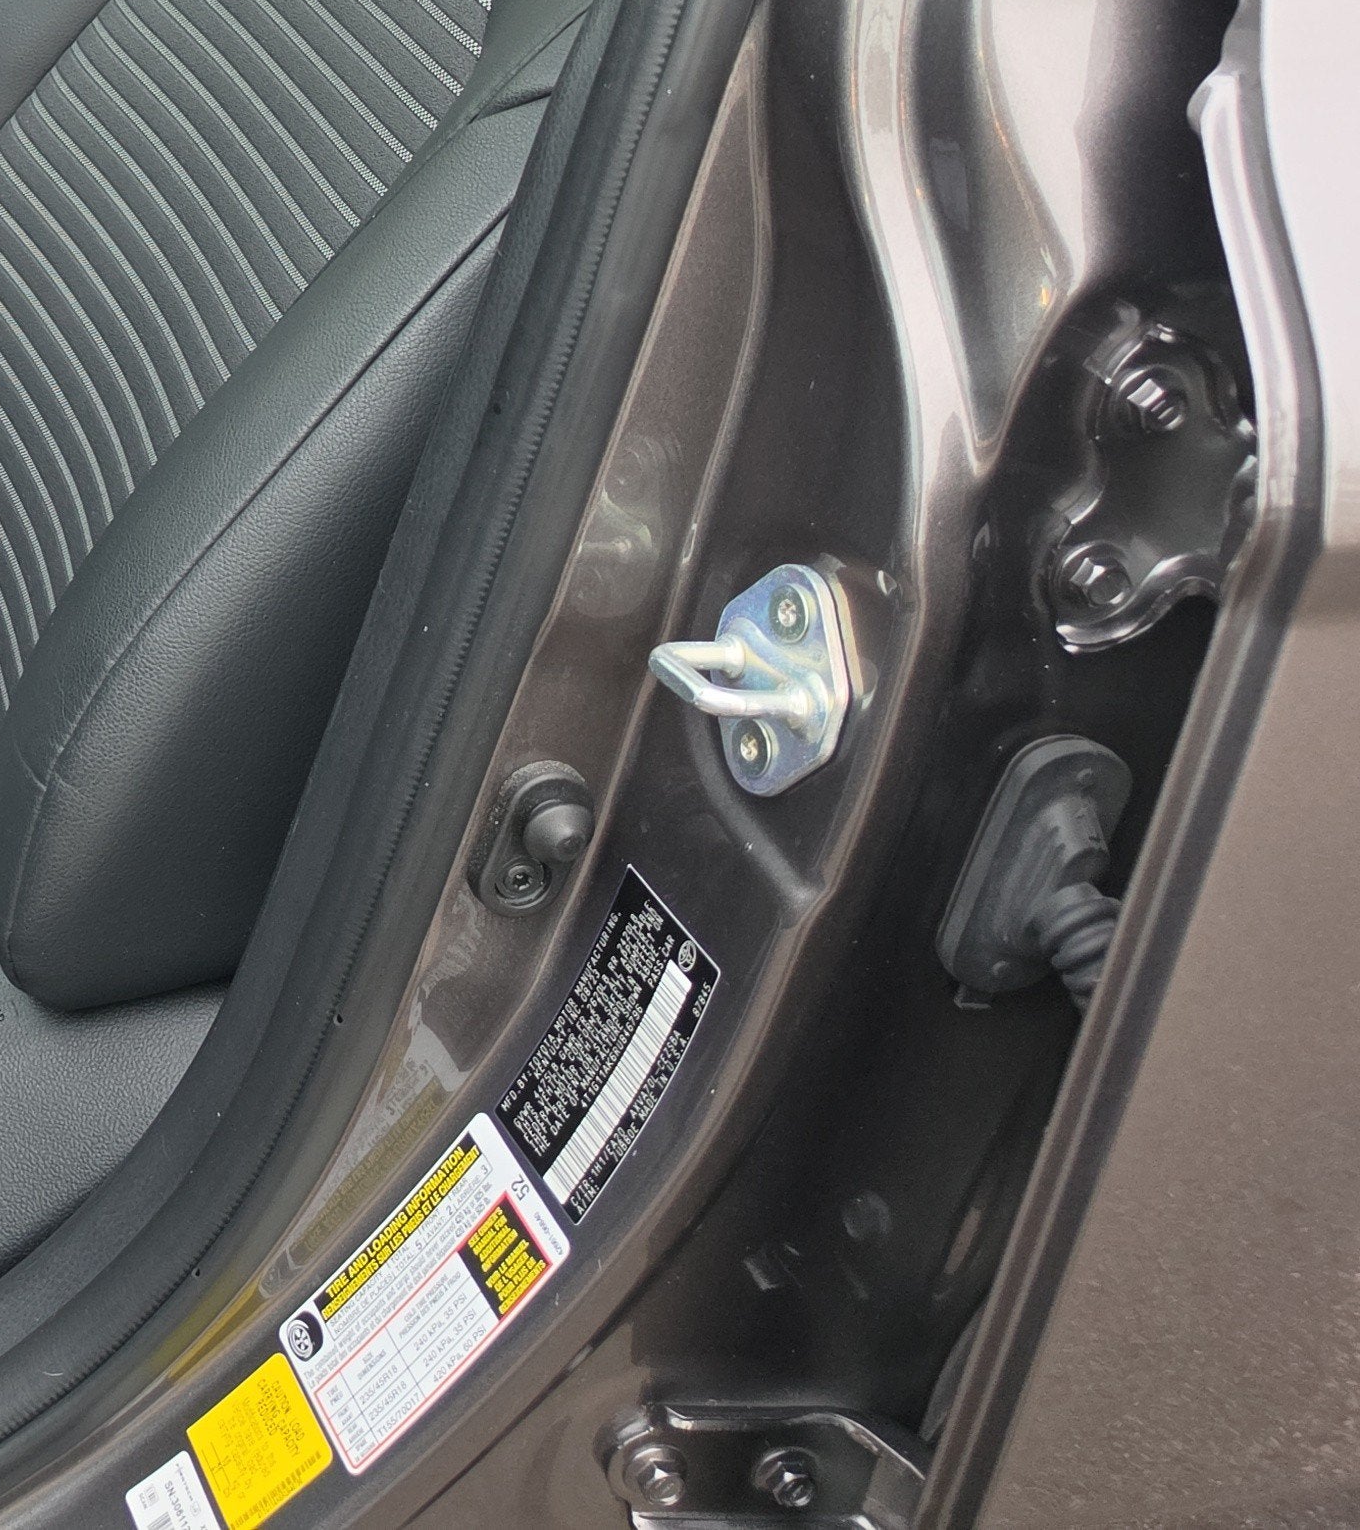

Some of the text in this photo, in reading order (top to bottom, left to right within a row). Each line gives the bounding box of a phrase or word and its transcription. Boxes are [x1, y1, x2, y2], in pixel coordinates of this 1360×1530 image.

[513, 911, 638, 1129] GVWR 4475LB GAWR FR 2620LB RR 2420LB
[518, 900, 652, 1136] THIS VEHICLE CONFORMS TO ALL APPLICABLE
[523, 1097, 554, 1144] FEDERAL
[553, 1062, 577, 1099] MOTOR
[576, 1016, 605, 1064] VEHICLE
[643, 906, 658, 931] AND
[529, 913, 664, 1151] THEFT PREVENTION STANDARDS IN EFFECT ON
[553, 996, 576, 1033] MOTOR
[534, 1135, 550, 1158] THE
[549, 1106, 570, 1136] DATE
[569, 1089, 581, 1107] OF
[580, 1018, 623, 1091] MANUFACTURE
[621, 982, 642, 1018] SHOWN
[637, 1090, 656, 1121] MADE
[656, 1071, 667, 1088] IN
[451, 1177, 468, 1196] REAR
[480, 1163, 488, 1175] 3
[509, 1173, 531, 1201] 52
[321, 1144, 482, 1322] RENSEIGNEMENTS SUR LES PNEUS ET LE CHARGEMENT
[325, 1145, 466, 1300] TIRE AND LOADING INFORMATION
[420, 1207, 441, 1231] FRONT
[445, 1204, 454, 1216] 2
[466, 1205, 504, 1249] SEE OWNER'S
[390, 1242, 409, 1265] TOTAL
[414, 1238, 423, 1251] 5
[471, 1214, 508, 1256] MANUAL FOR
[476, 1222, 512, 1263] ADDITIONAL
[479, 1227, 520, 1273] INFORMATION
[484, 1237, 530, 1289] VOIR LE MANUEL
[493, 1278, 505, 1293] DE
[497, 1255, 536, 1302] POUR PLUS DE
[329, 1269, 383, 1328] SEATING CAPACITY
[334, 1273, 392, 1336] NOMBRE DE PLACES
[496, 1258, 548, 1315] RENSEIGNEMENTS
[413, 1332, 429, 1351] 240
[443, 1305, 454, 1319] 35
[452, 1291, 467, 1309] PSI
[422, 1348, 438, 1367] 240
[452, 1322, 463, 1336] 35
[462, 1307, 477, 1325] PSI
[357, 1348, 386, 1381] DIMENSIONS
[431, 1365, 447, 1384] 420
[461, 1338, 473, 1352] 60
[471, 1324, 486, 1341] PSI
[359, 1362, 398, 1406] 235/45R18
[368, 1378, 407, 1422] 235/45R18
[254, 1397, 279, 1437] REDUCED
[256, 1376, 281, 1419] CARRYING
[275, 1418, 300, 1459] CAPACITY
[288, 1416, 306, 1442] LOAD
[378, 1391, 421, 1438] T155/70D17
